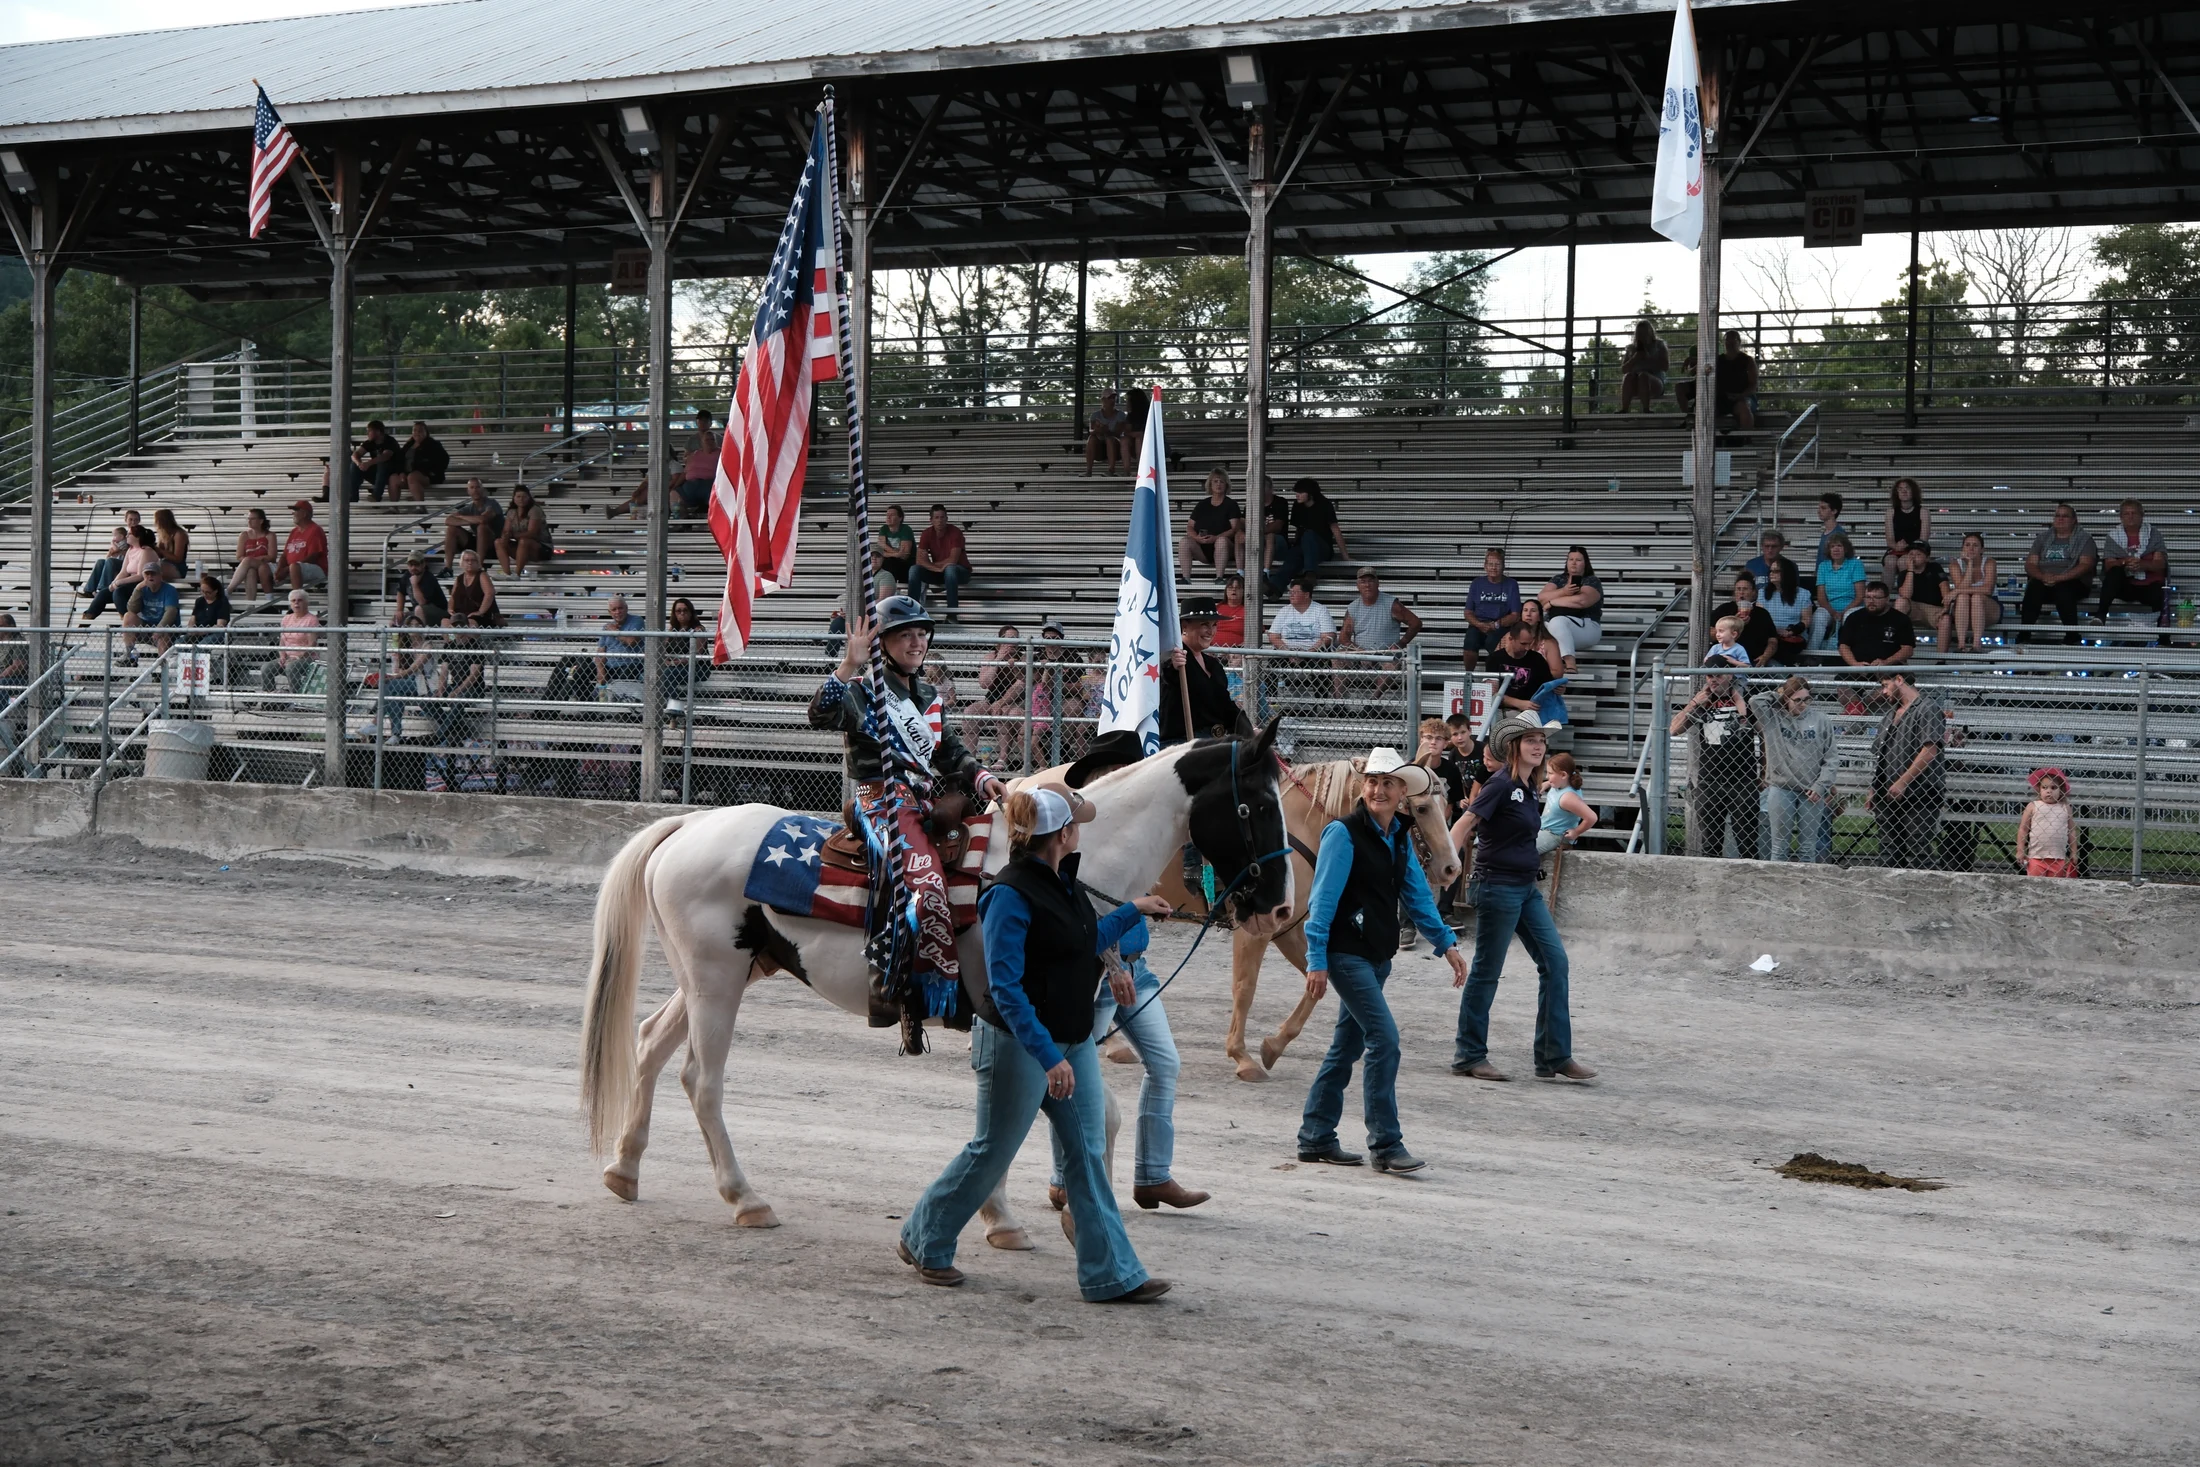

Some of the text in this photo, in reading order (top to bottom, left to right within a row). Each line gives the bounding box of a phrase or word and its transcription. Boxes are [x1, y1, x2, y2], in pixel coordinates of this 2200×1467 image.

[1812, 207, 1856, 229] C D
[1101, 633, 1155, 723] York
[1450, 688, 1487, 697] SECONS
[1470, 699, 1484, 716] D
[900, 715, 924, 745] New
[907, 852, 932, 872] Lil
[921, 915, 953, 946] New
[919, 941, 960, 974] York
